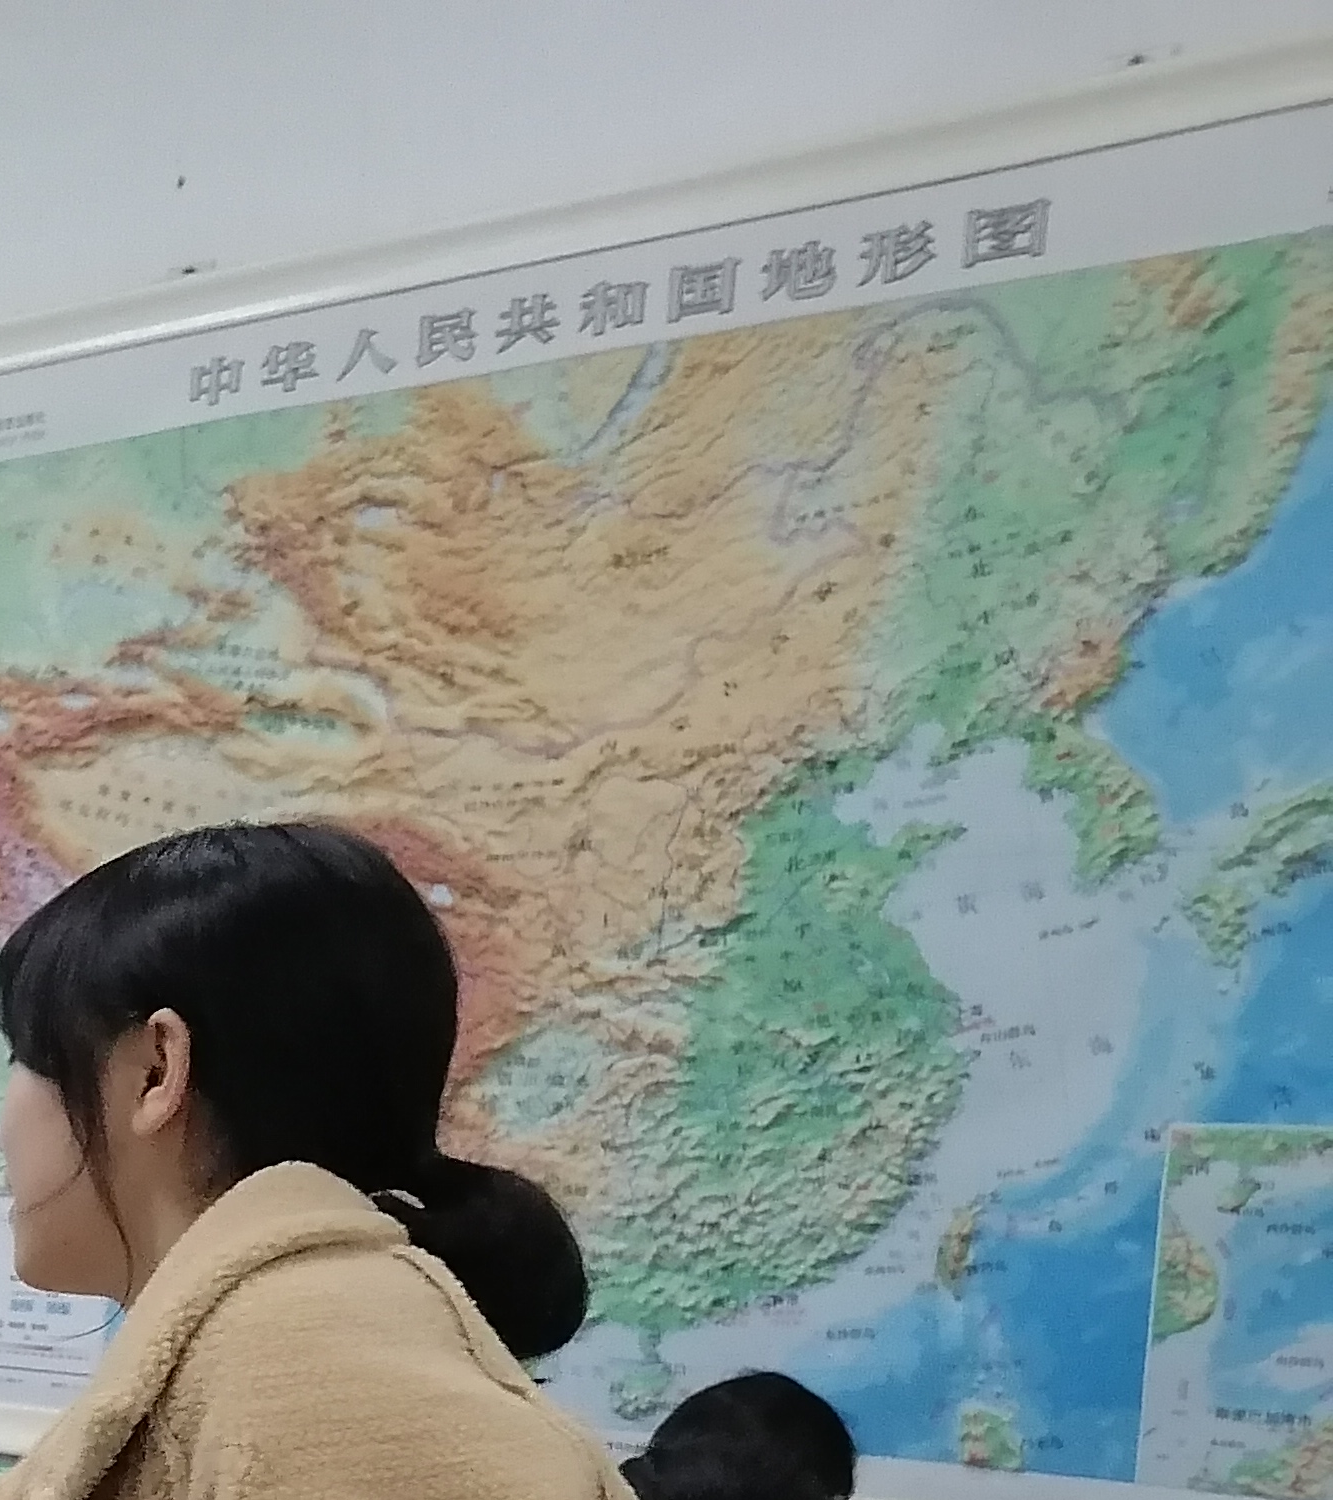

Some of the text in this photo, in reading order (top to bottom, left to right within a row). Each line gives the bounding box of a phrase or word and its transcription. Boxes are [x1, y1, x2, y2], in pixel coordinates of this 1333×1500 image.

[188, 198, 1051, 406] 中华人民共和国地形图
